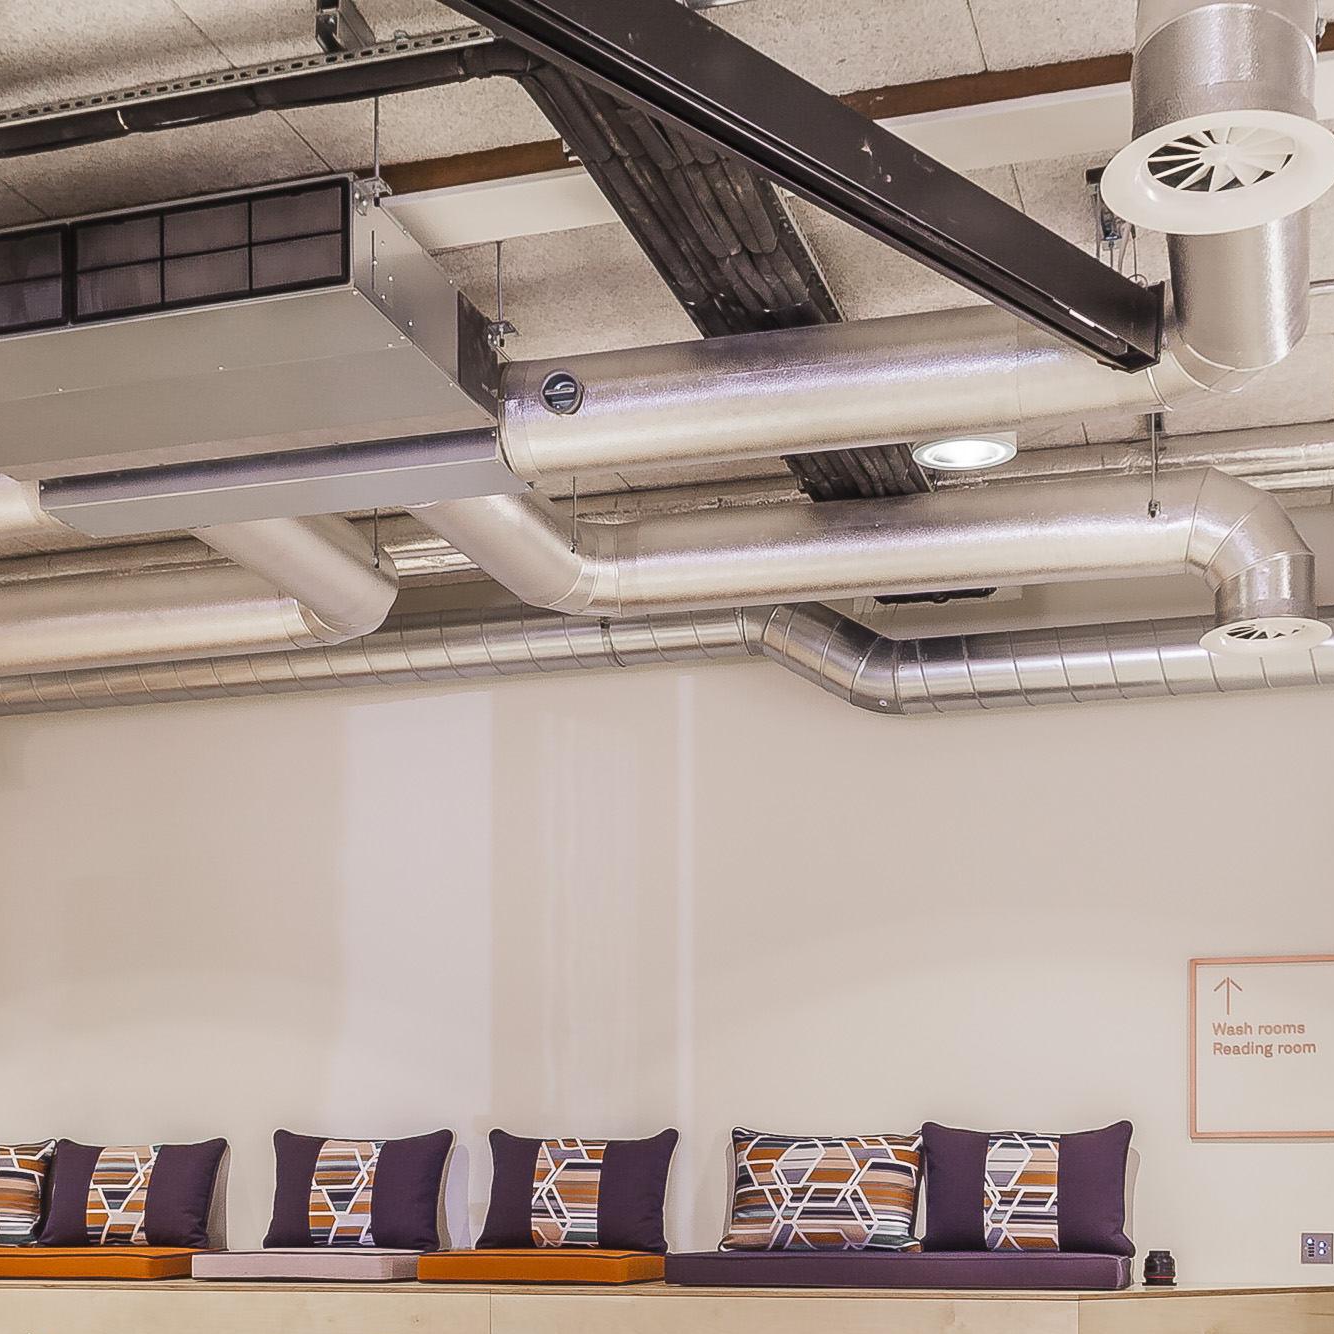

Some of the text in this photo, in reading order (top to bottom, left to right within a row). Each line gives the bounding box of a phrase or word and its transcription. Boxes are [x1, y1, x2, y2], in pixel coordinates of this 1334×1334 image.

[1212, 1021, 1306, 1036] Wash rooms
[1213, 1041, 1317, 1058] Reading room
